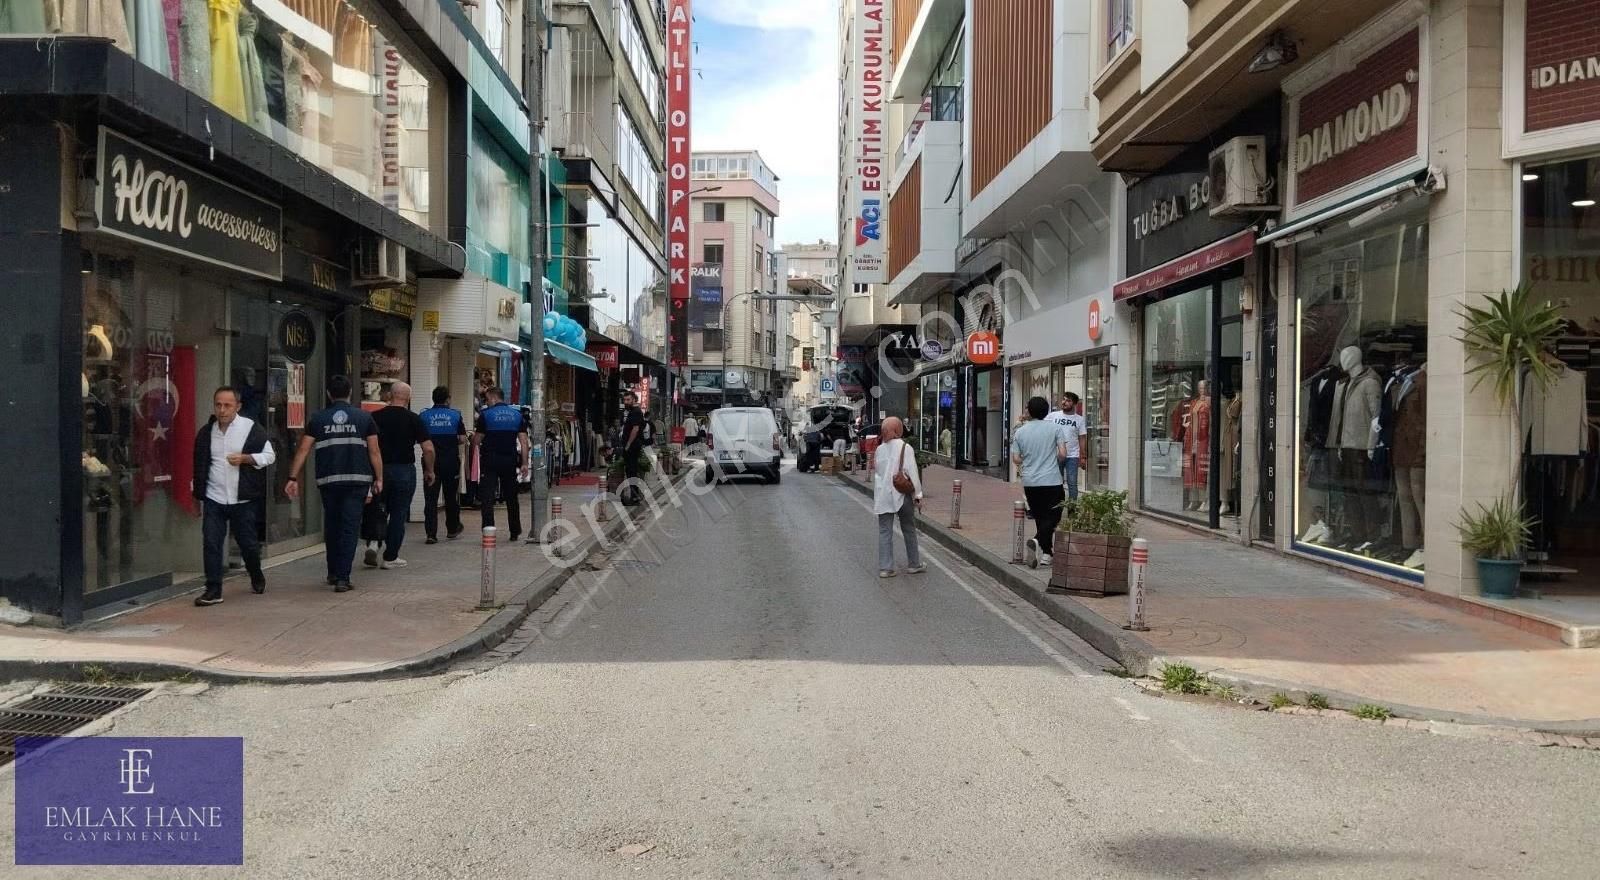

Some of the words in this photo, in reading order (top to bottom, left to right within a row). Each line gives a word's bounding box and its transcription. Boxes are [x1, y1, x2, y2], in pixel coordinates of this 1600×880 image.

[857, 119, 881, 191] EĞİTİM
[1296, 83, 1412, 174] DIAMOND
[198, 203, 278, 253] accessoriess
[670, 109, 686, 285] OTOPARK
[861, 199, 881, 241] AÇI
[1132, 194, 1184, 240] TUĞBA
[1188, 174, 1211, 211] BO
[323, 424, 357, 434] ZABITA
